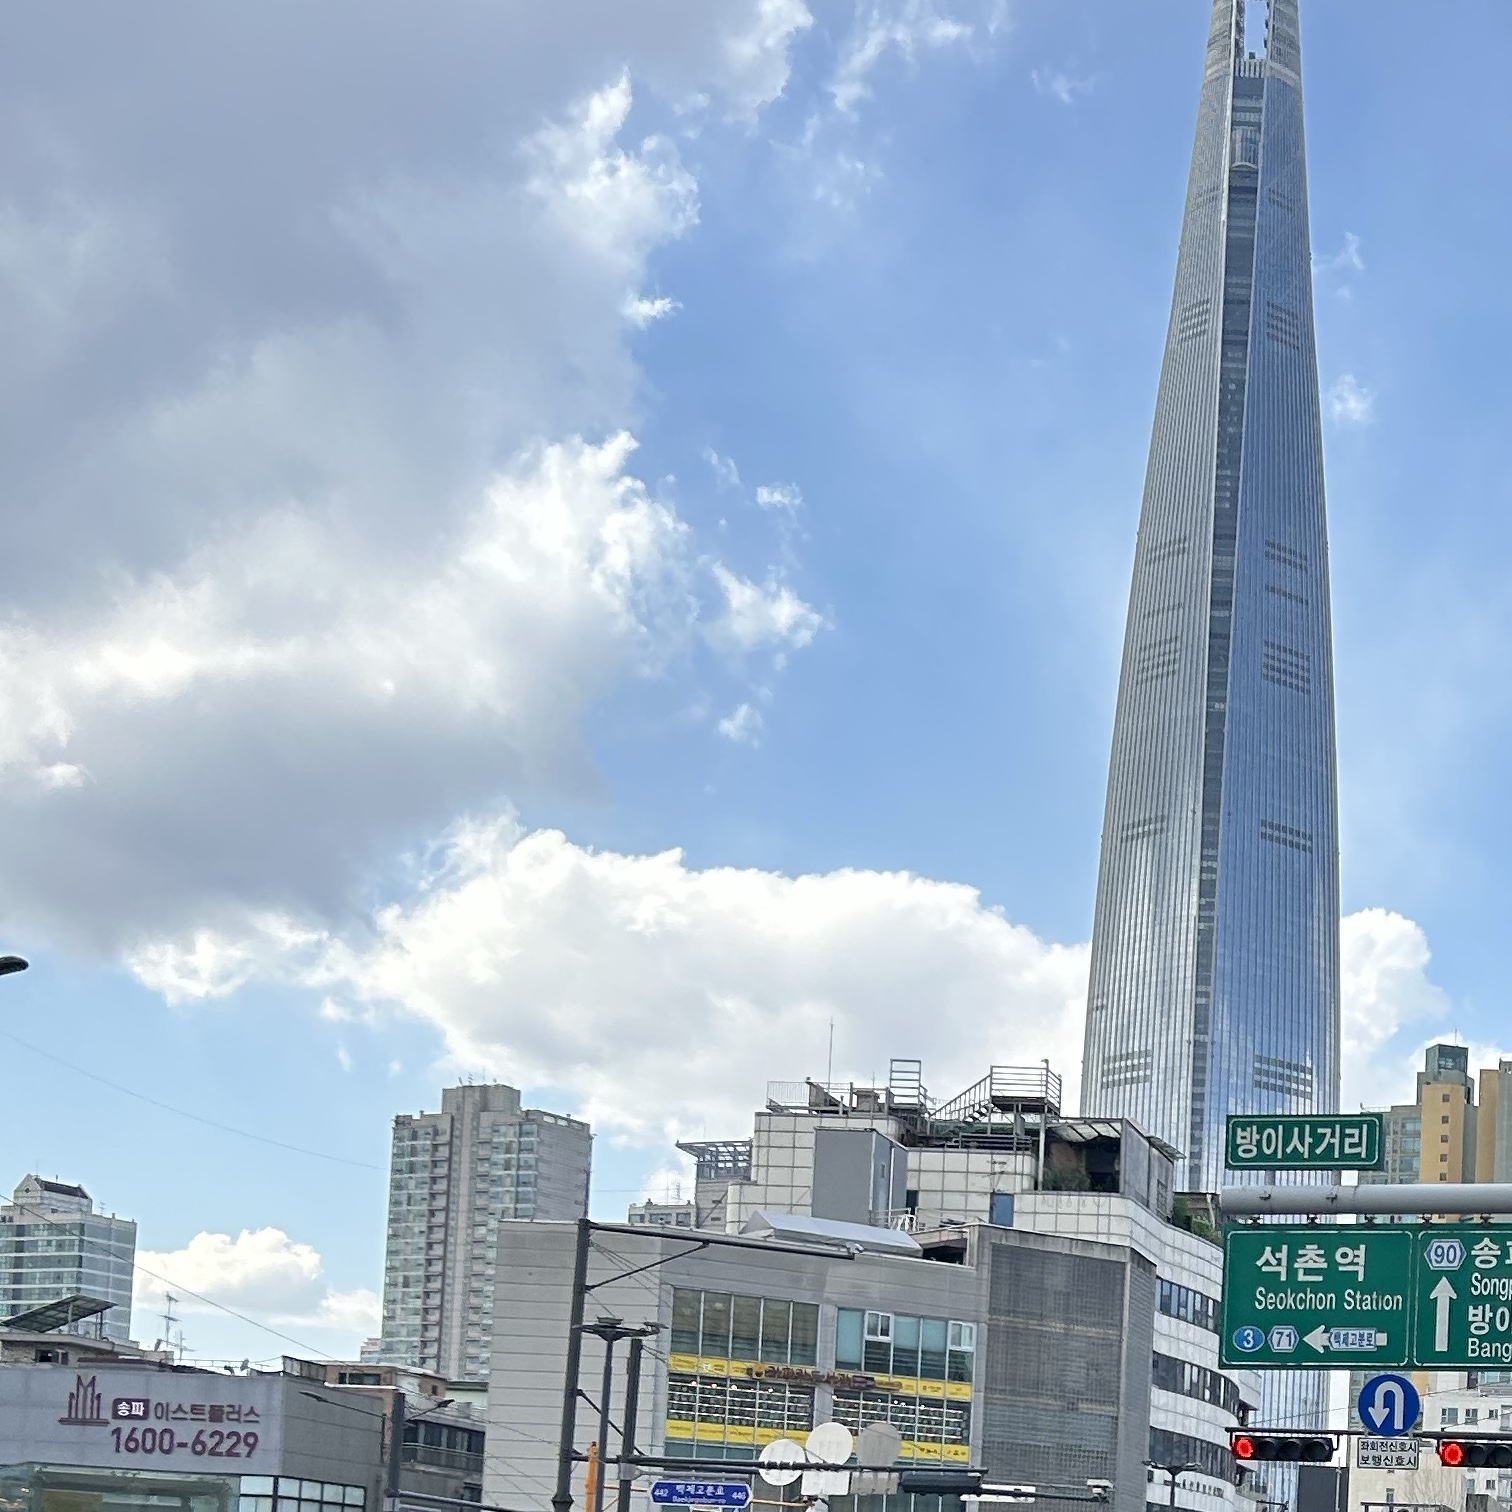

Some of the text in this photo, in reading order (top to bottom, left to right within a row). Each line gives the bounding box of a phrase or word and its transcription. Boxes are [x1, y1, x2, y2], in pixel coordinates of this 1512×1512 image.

[1236, 1123, 1368, 1159] 방이사거리
[1255, 1244, 1367, 1281] 석촌역
[1433, 1245, 1457, 1264] 90
[1255, 1286, 1403, 1311] Seokchon Station
[1243, 1330, 1254, 1348] 3
[1275, 1331, 1292, 1348] 71
[116, 1401, 145, 1417] 송파
[111, 1426, 259, 1458] 1600-6229
[1360, 1440, 1417, 1453] 좌회전신호시
[1360, 1454, 1417, 1467] 보행신호시
